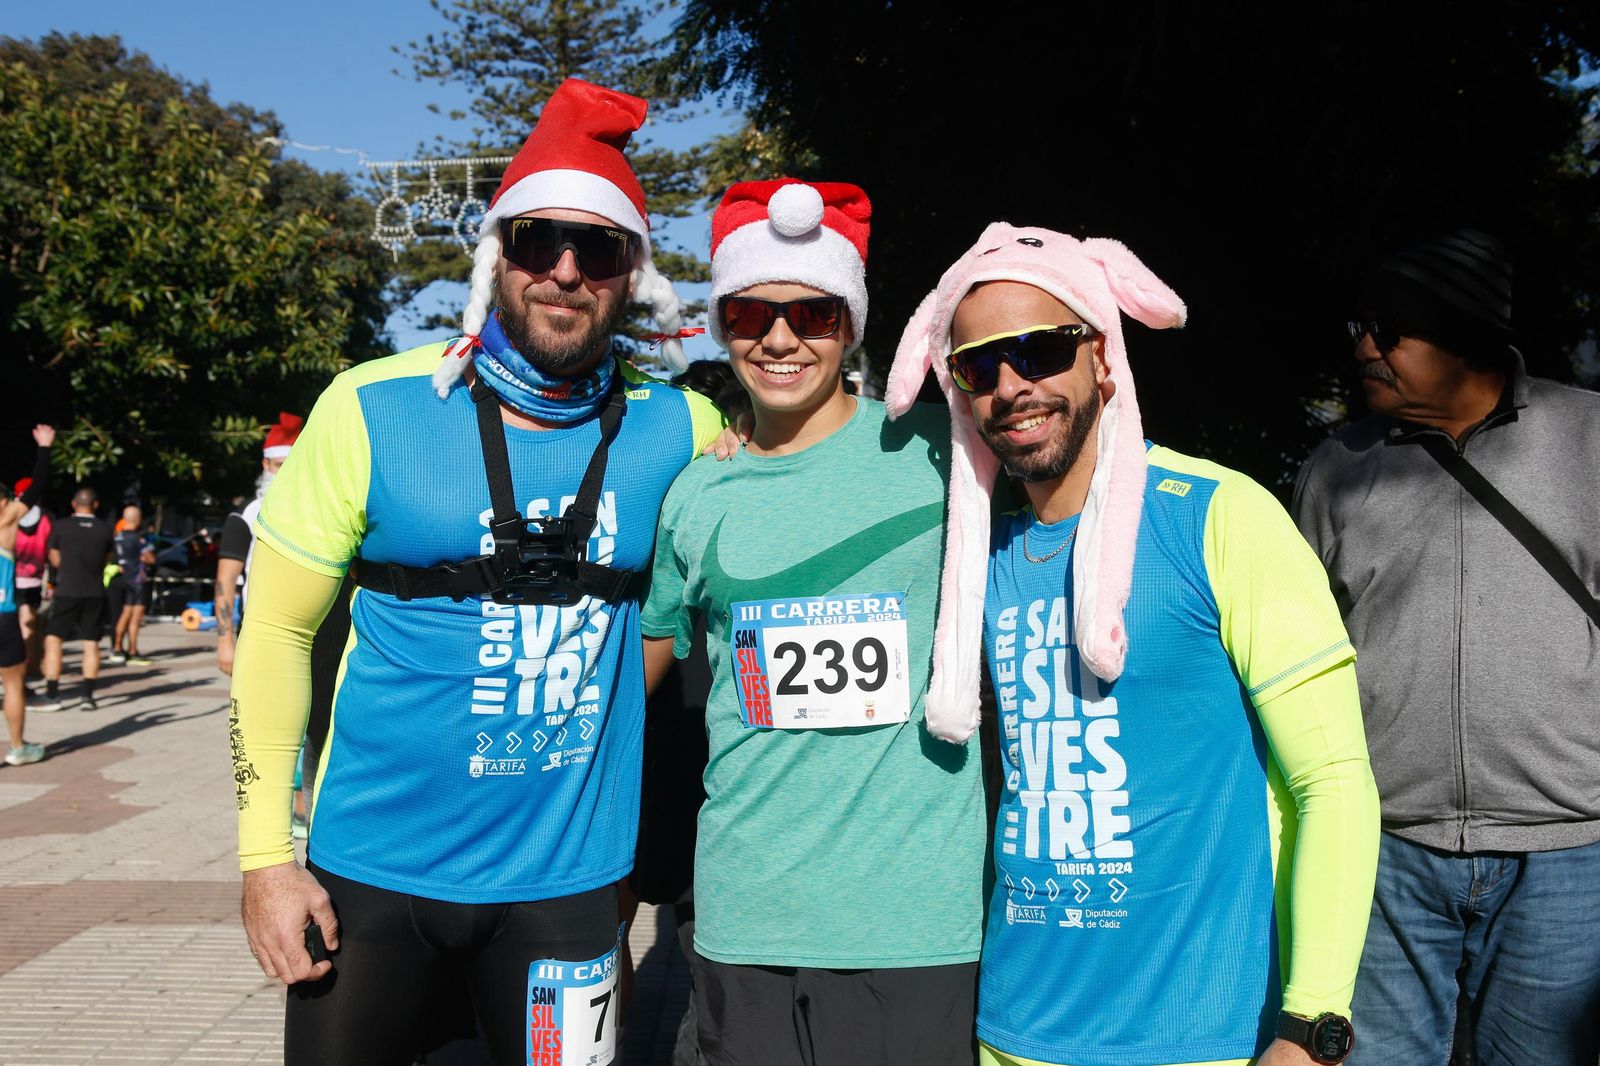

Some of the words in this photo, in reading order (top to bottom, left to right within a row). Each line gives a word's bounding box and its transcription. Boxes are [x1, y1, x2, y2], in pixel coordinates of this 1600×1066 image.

[1170, 482, 1188, 495] RH
[740, 605, 762, 622] III
[771, 597, 901, 619] CARRERA
[804, 614, 857, 626] TARIFA
[867, 612, 901, 623] 2024
[735, 629, 758, 649] SAN
[736, 648, 762, 675] SIL
[773, 637, 888, 695] 239
[471, 677, 508, 715] III
[740, 675, 771, 701] VES
[1022, 649, 1119, 719] SIL
[574, 703, 599, 717] 2024
[744, 700, 774, 727] TRE
[1020, 718, 1127, 791] VES
[485, 762, 526, 772] TARIFA
[1003, 811, 1019, 855] III
[1019, 790, 1134, 860] TRE
[1054, 862, 1096, 876] TARIFA
[1098, 861, 1133, 875] 2024
[1012, 907, 1047, 921] TARIFA
[1085, 908, 1128, 919] Diputación
[1086, 919, 1097, 929] de
[1099, 918, 1121, 929] Cádiz
[538, 964, 564, 980] III
[532, 986, 556, 1006] SAN
[531, 1004, 556, 1029] SIL
[531, 1029, 562, 1053] VES
